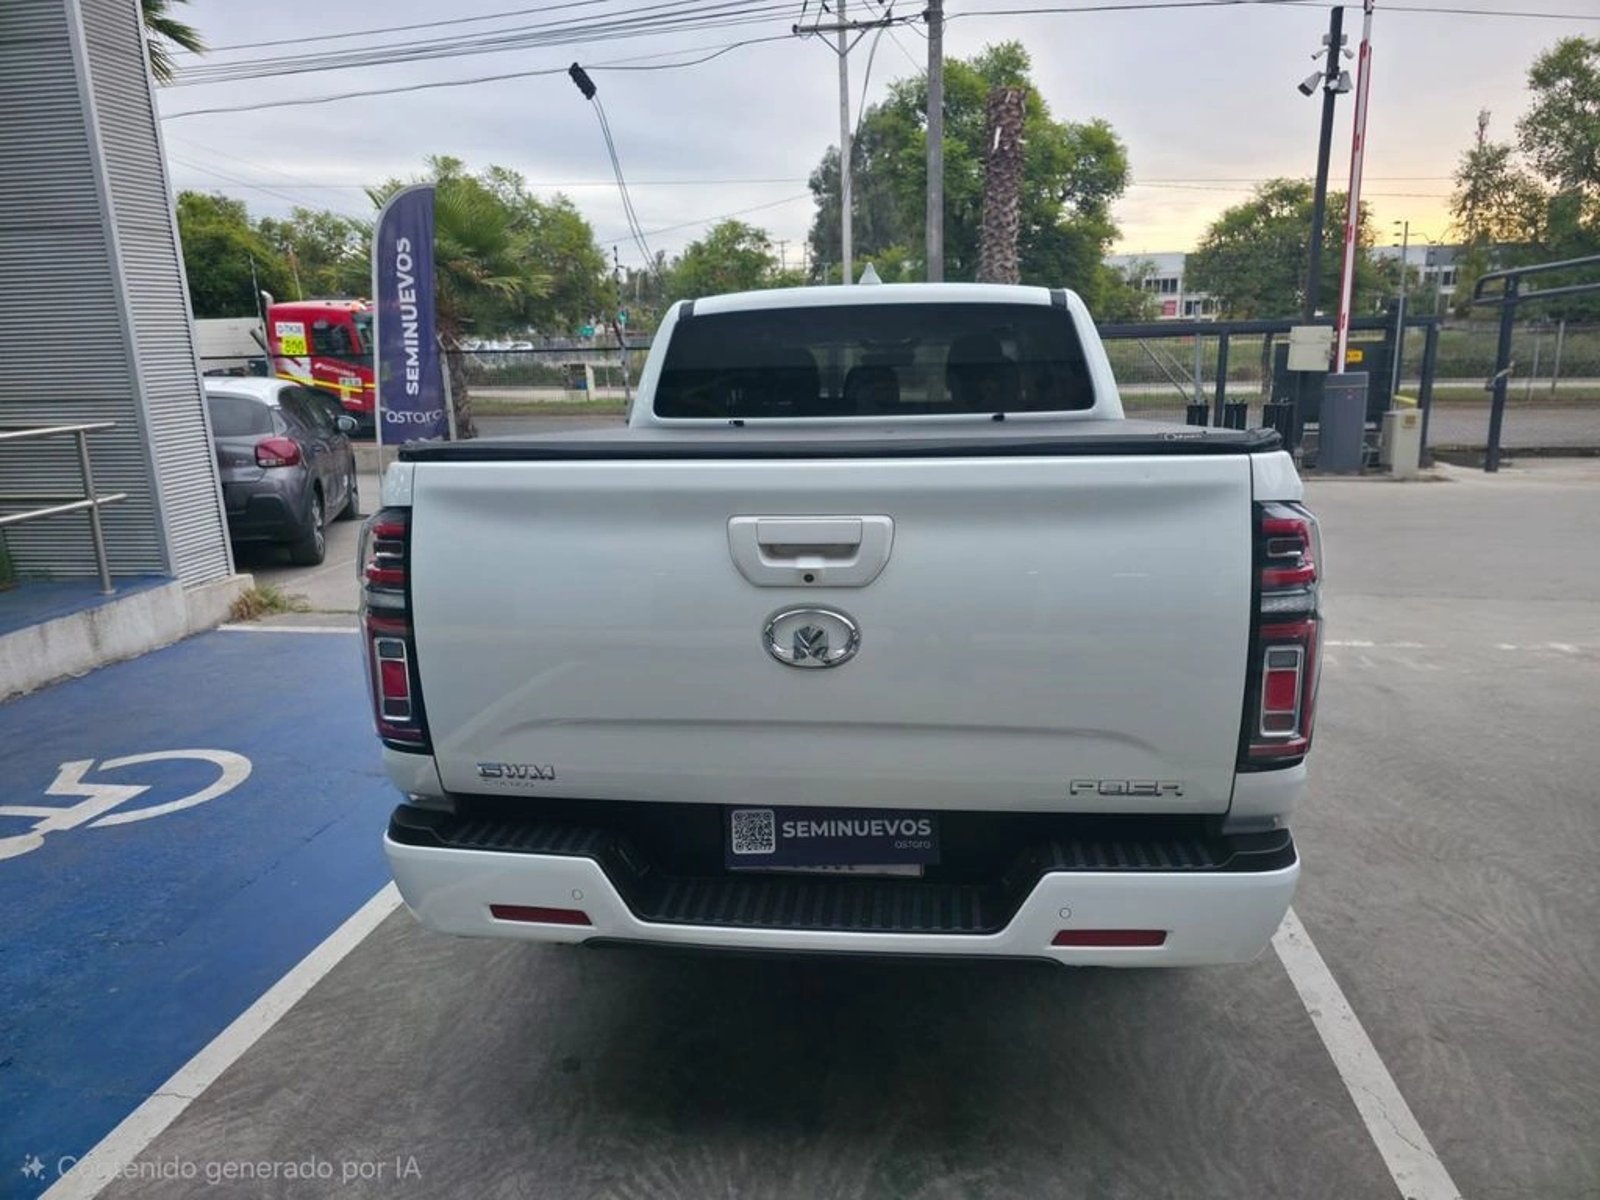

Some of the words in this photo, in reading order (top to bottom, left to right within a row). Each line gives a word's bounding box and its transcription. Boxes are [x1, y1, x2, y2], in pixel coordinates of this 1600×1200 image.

[396, 237, 420, 396] SEMINUEVOS
[476, 762, 556, 780] GWM
[782, 819, 932, 838] SEMINUEVOS
